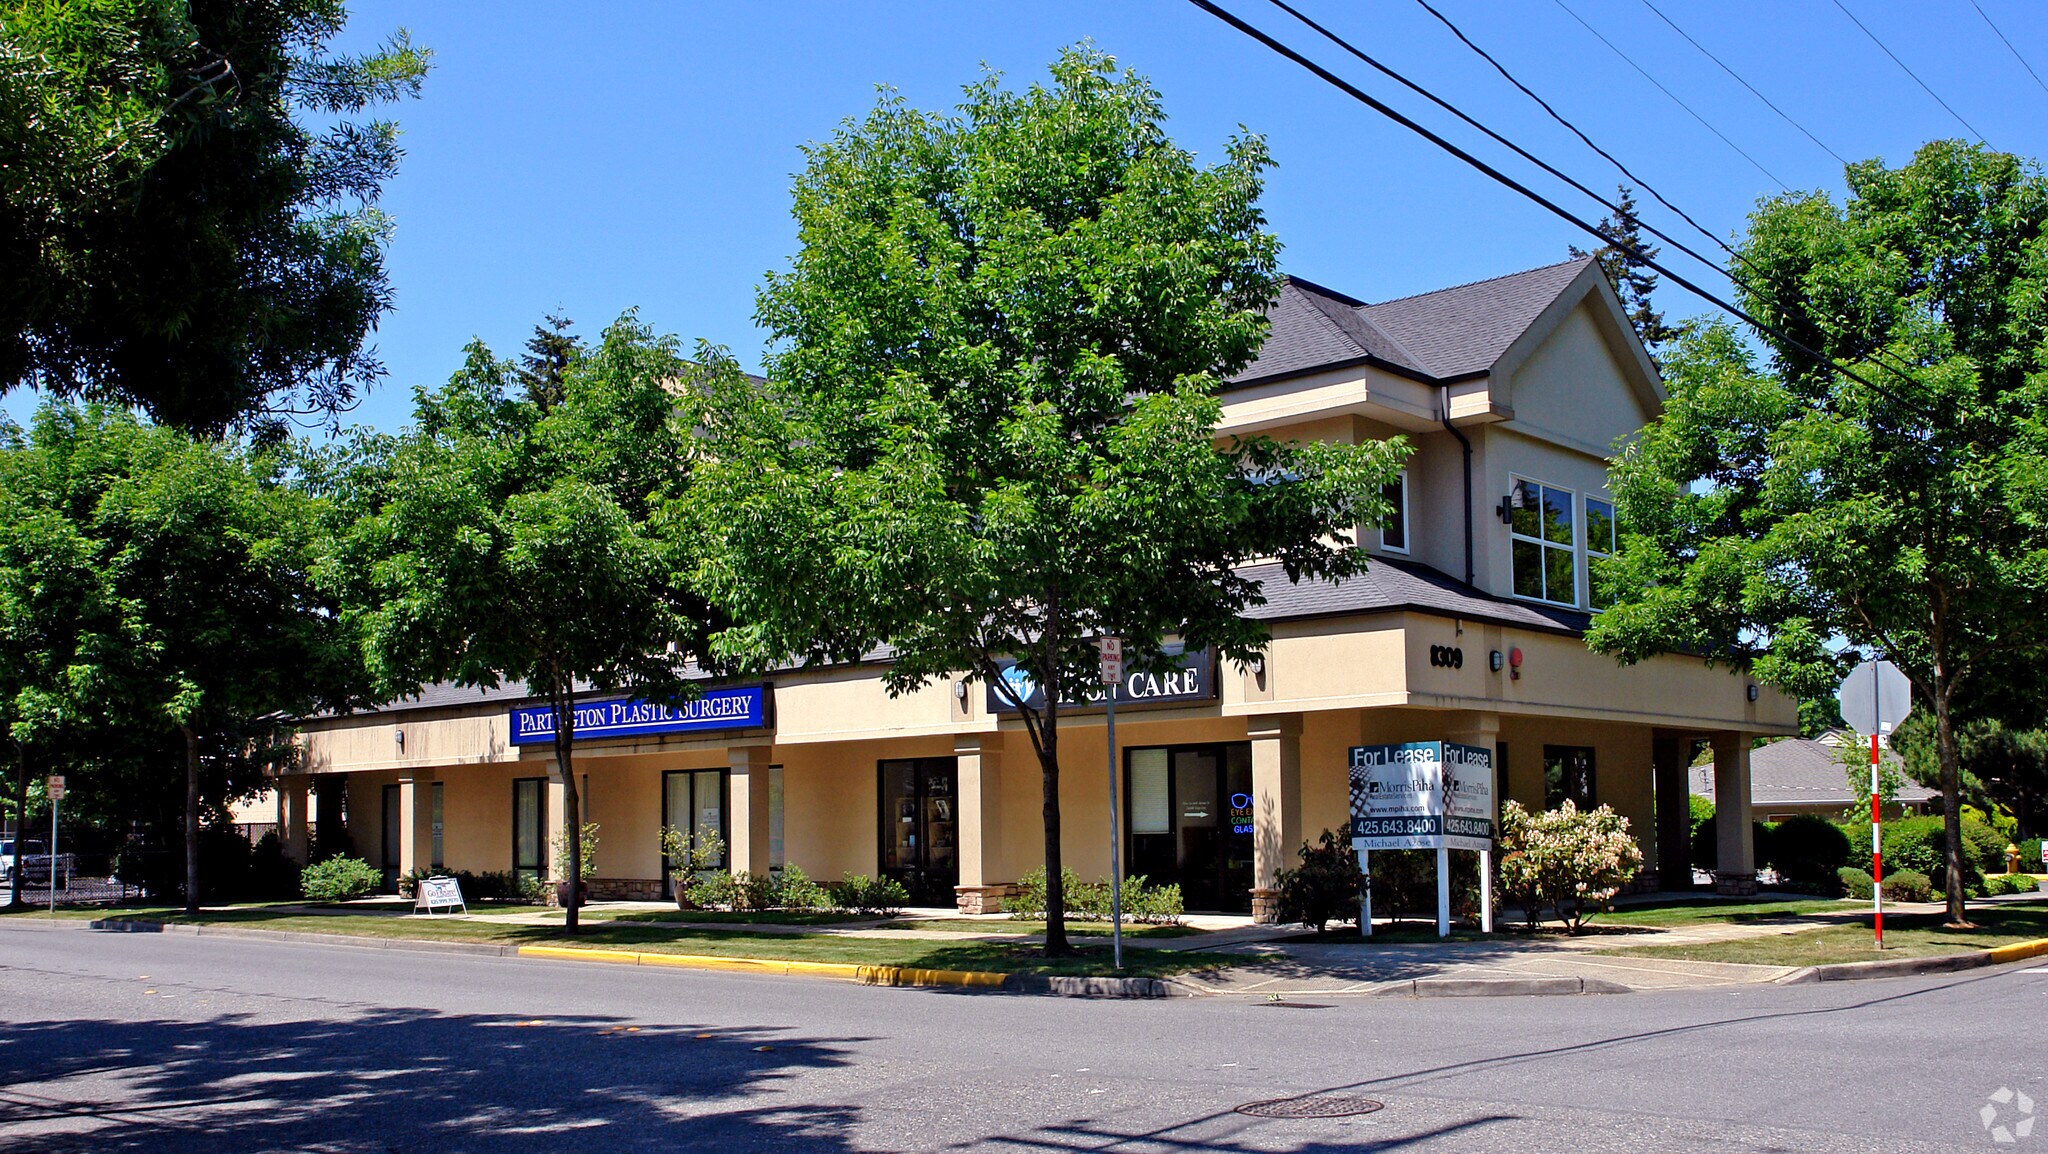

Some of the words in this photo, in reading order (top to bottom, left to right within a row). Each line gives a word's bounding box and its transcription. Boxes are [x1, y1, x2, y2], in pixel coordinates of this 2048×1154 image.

[1106, 642, 1115, 650] NO
[1102, 653, 1120, 662] PARKING
[1128, 668, 1199, 699] CARE
[520, 707, 606, 732] PARTGTON
[1354, 748, 1382, 766] For
[1385, 746, 1434, 765] Lease
[1444, 743, 1460, 763] For
[1461, 746, 1489, 768] Lease
[1231, 808, 1244, 816] EYE
[1370, 804, 1425, 813] www.mpiha.com
[1358, 819, 1436, 834] 425.643.8400
[1446, 819, 1490, 836] 425.643.8400
[1364, 839, 1400, 848] Michael
